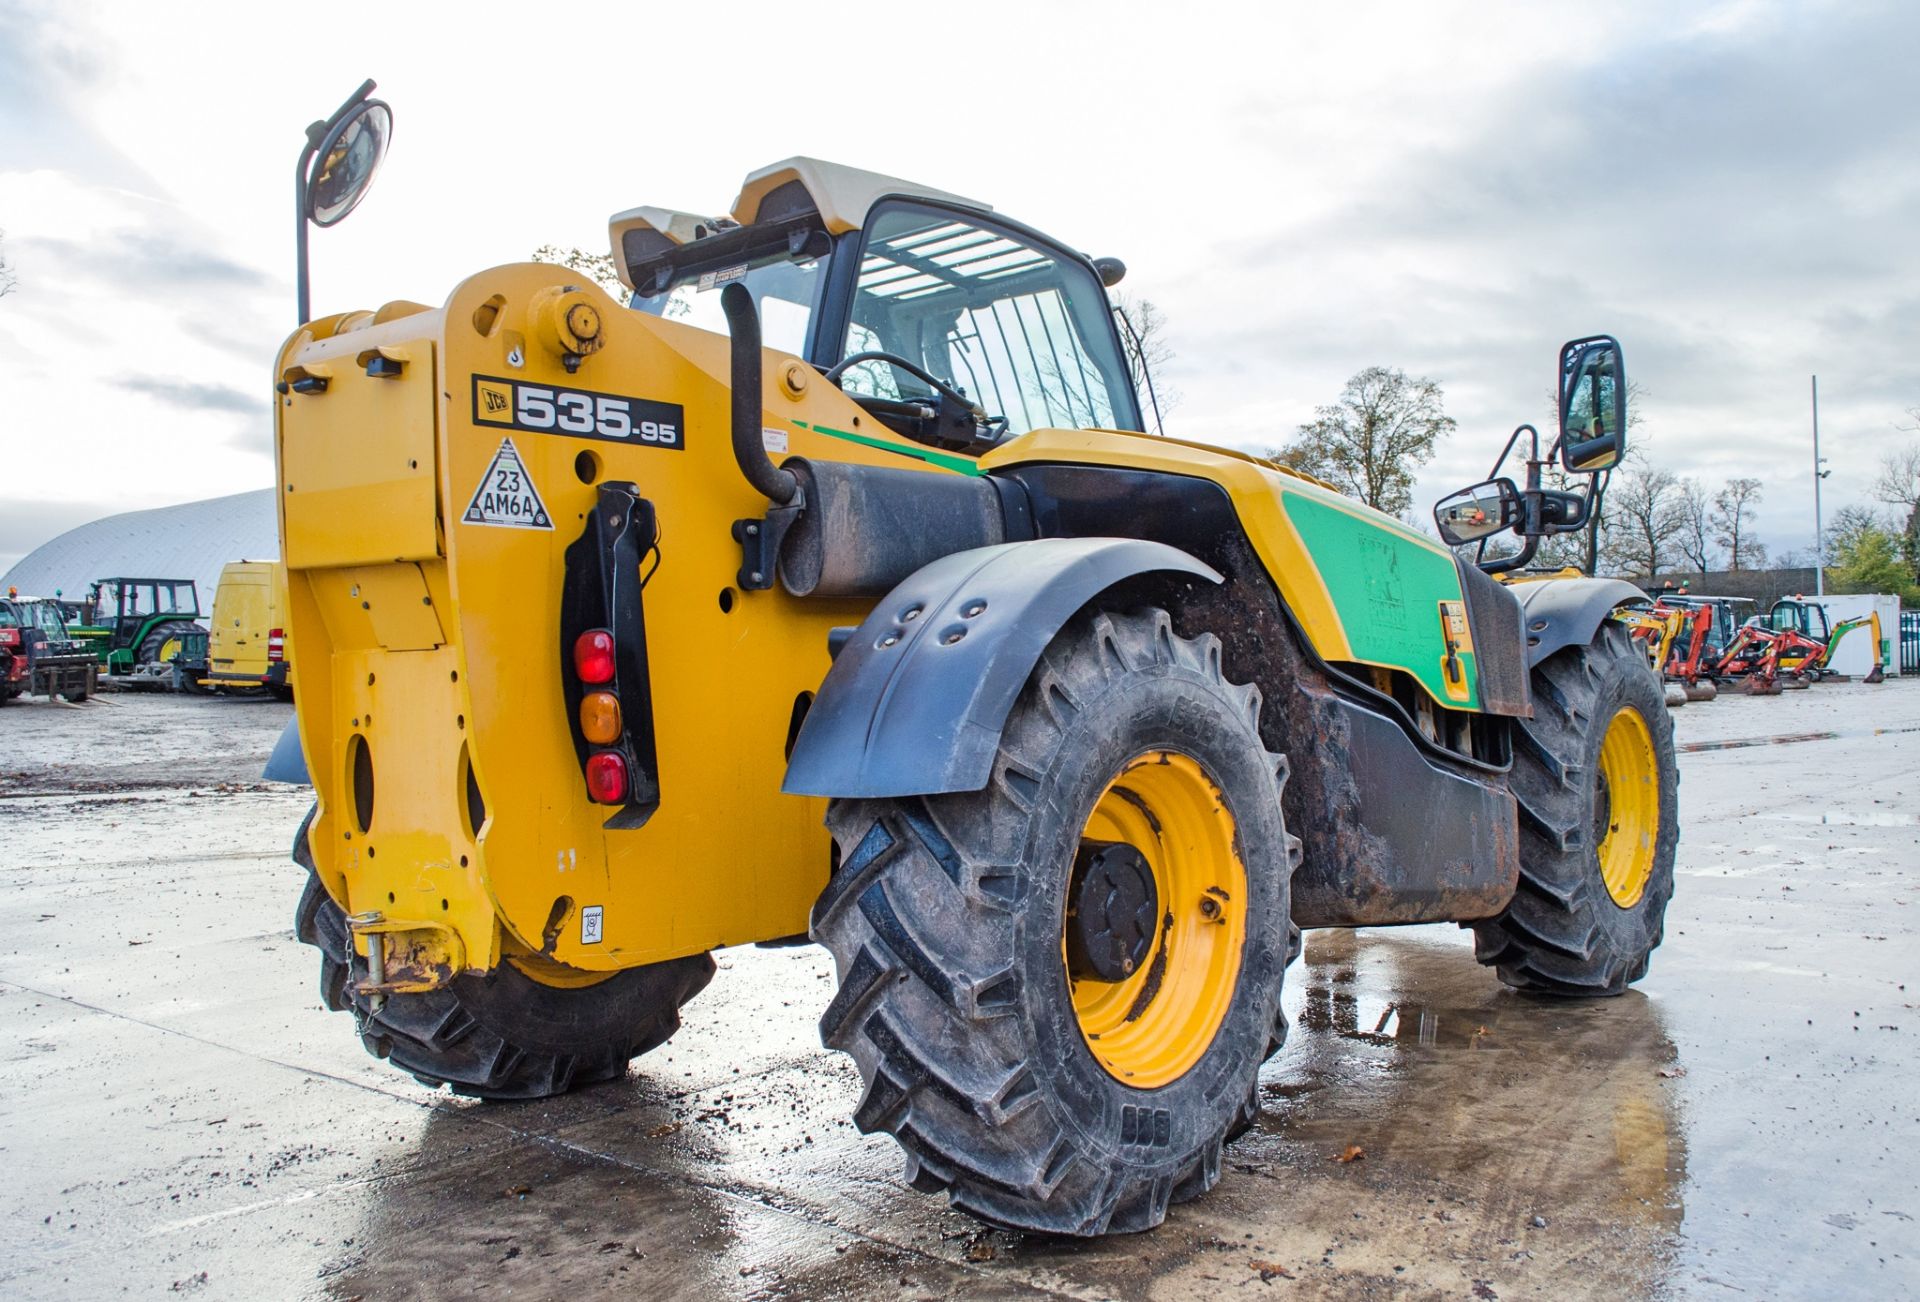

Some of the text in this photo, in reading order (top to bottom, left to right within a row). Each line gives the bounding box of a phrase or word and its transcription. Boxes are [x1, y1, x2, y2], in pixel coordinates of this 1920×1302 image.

[486, 390, 508, 411] JCB
[497, 470, 520, 492] 23
[484, 492, 534, 517] AM6A
